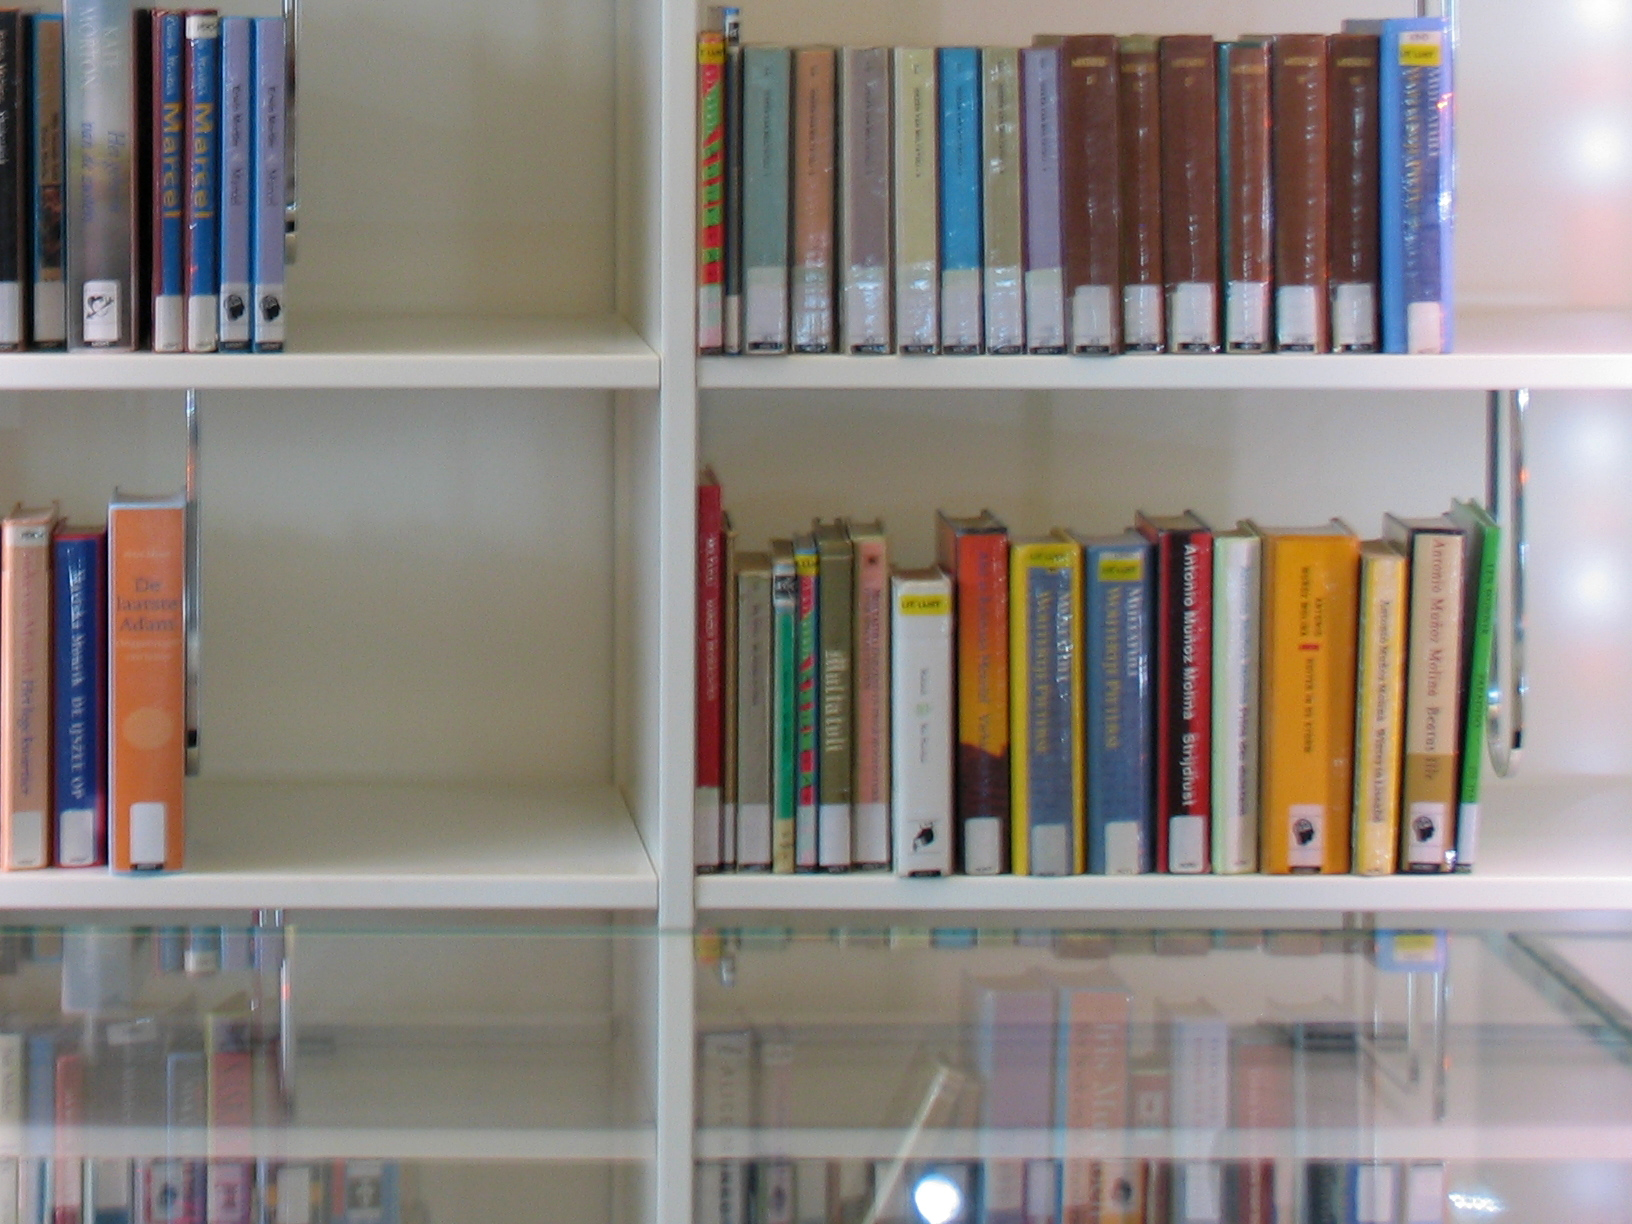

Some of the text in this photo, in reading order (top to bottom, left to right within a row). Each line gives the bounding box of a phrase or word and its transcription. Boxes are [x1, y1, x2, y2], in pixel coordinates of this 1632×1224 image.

[162, 102, 183, 218] Marcel
[194, 102, 214, 218] Marcel
[134, 577, 163, 592] De
[1431, 540, 1446, 594] Antonio
[1430, 598, 1446, 644] Muñoz
[1179, 544, 1202, 807] Antonio Muñoz Molina Strijdlust
[1427, 648, 1444, 697] Molina
[70, 695, 85, 714] DE
[824, 650, 848, 752] Multatuli
[70, 776, 85, 799] OP
